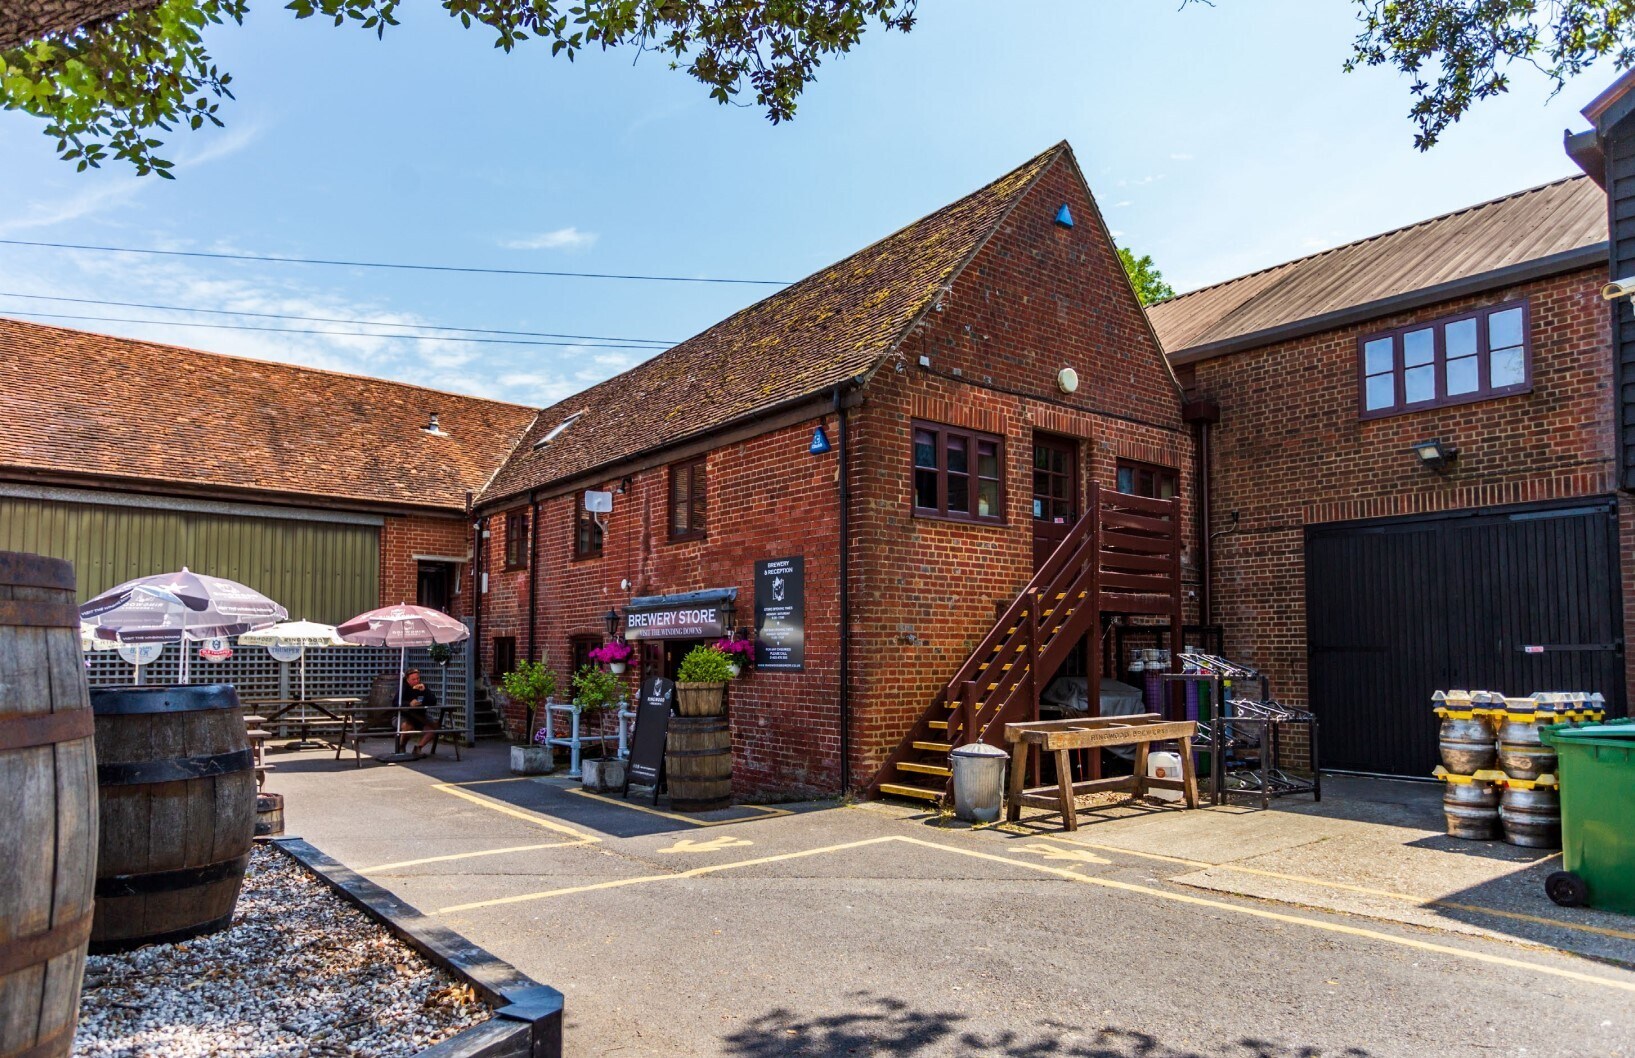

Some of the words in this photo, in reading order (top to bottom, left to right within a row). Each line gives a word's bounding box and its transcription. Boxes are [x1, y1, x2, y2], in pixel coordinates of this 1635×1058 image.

[767, 560, 790, 568] BREWERY
[628, 611, 678, 628] BREWERY
[678, 608, 716, 624] STORE
[640, 628, 650, 637] VISIT
[651, 628, 660, 636] THE
[660, 628, 682, 636] WINDING
[683, 626, 703, 635] DOWNS
[1090, 732, 1130, 740] RINGWOOD
